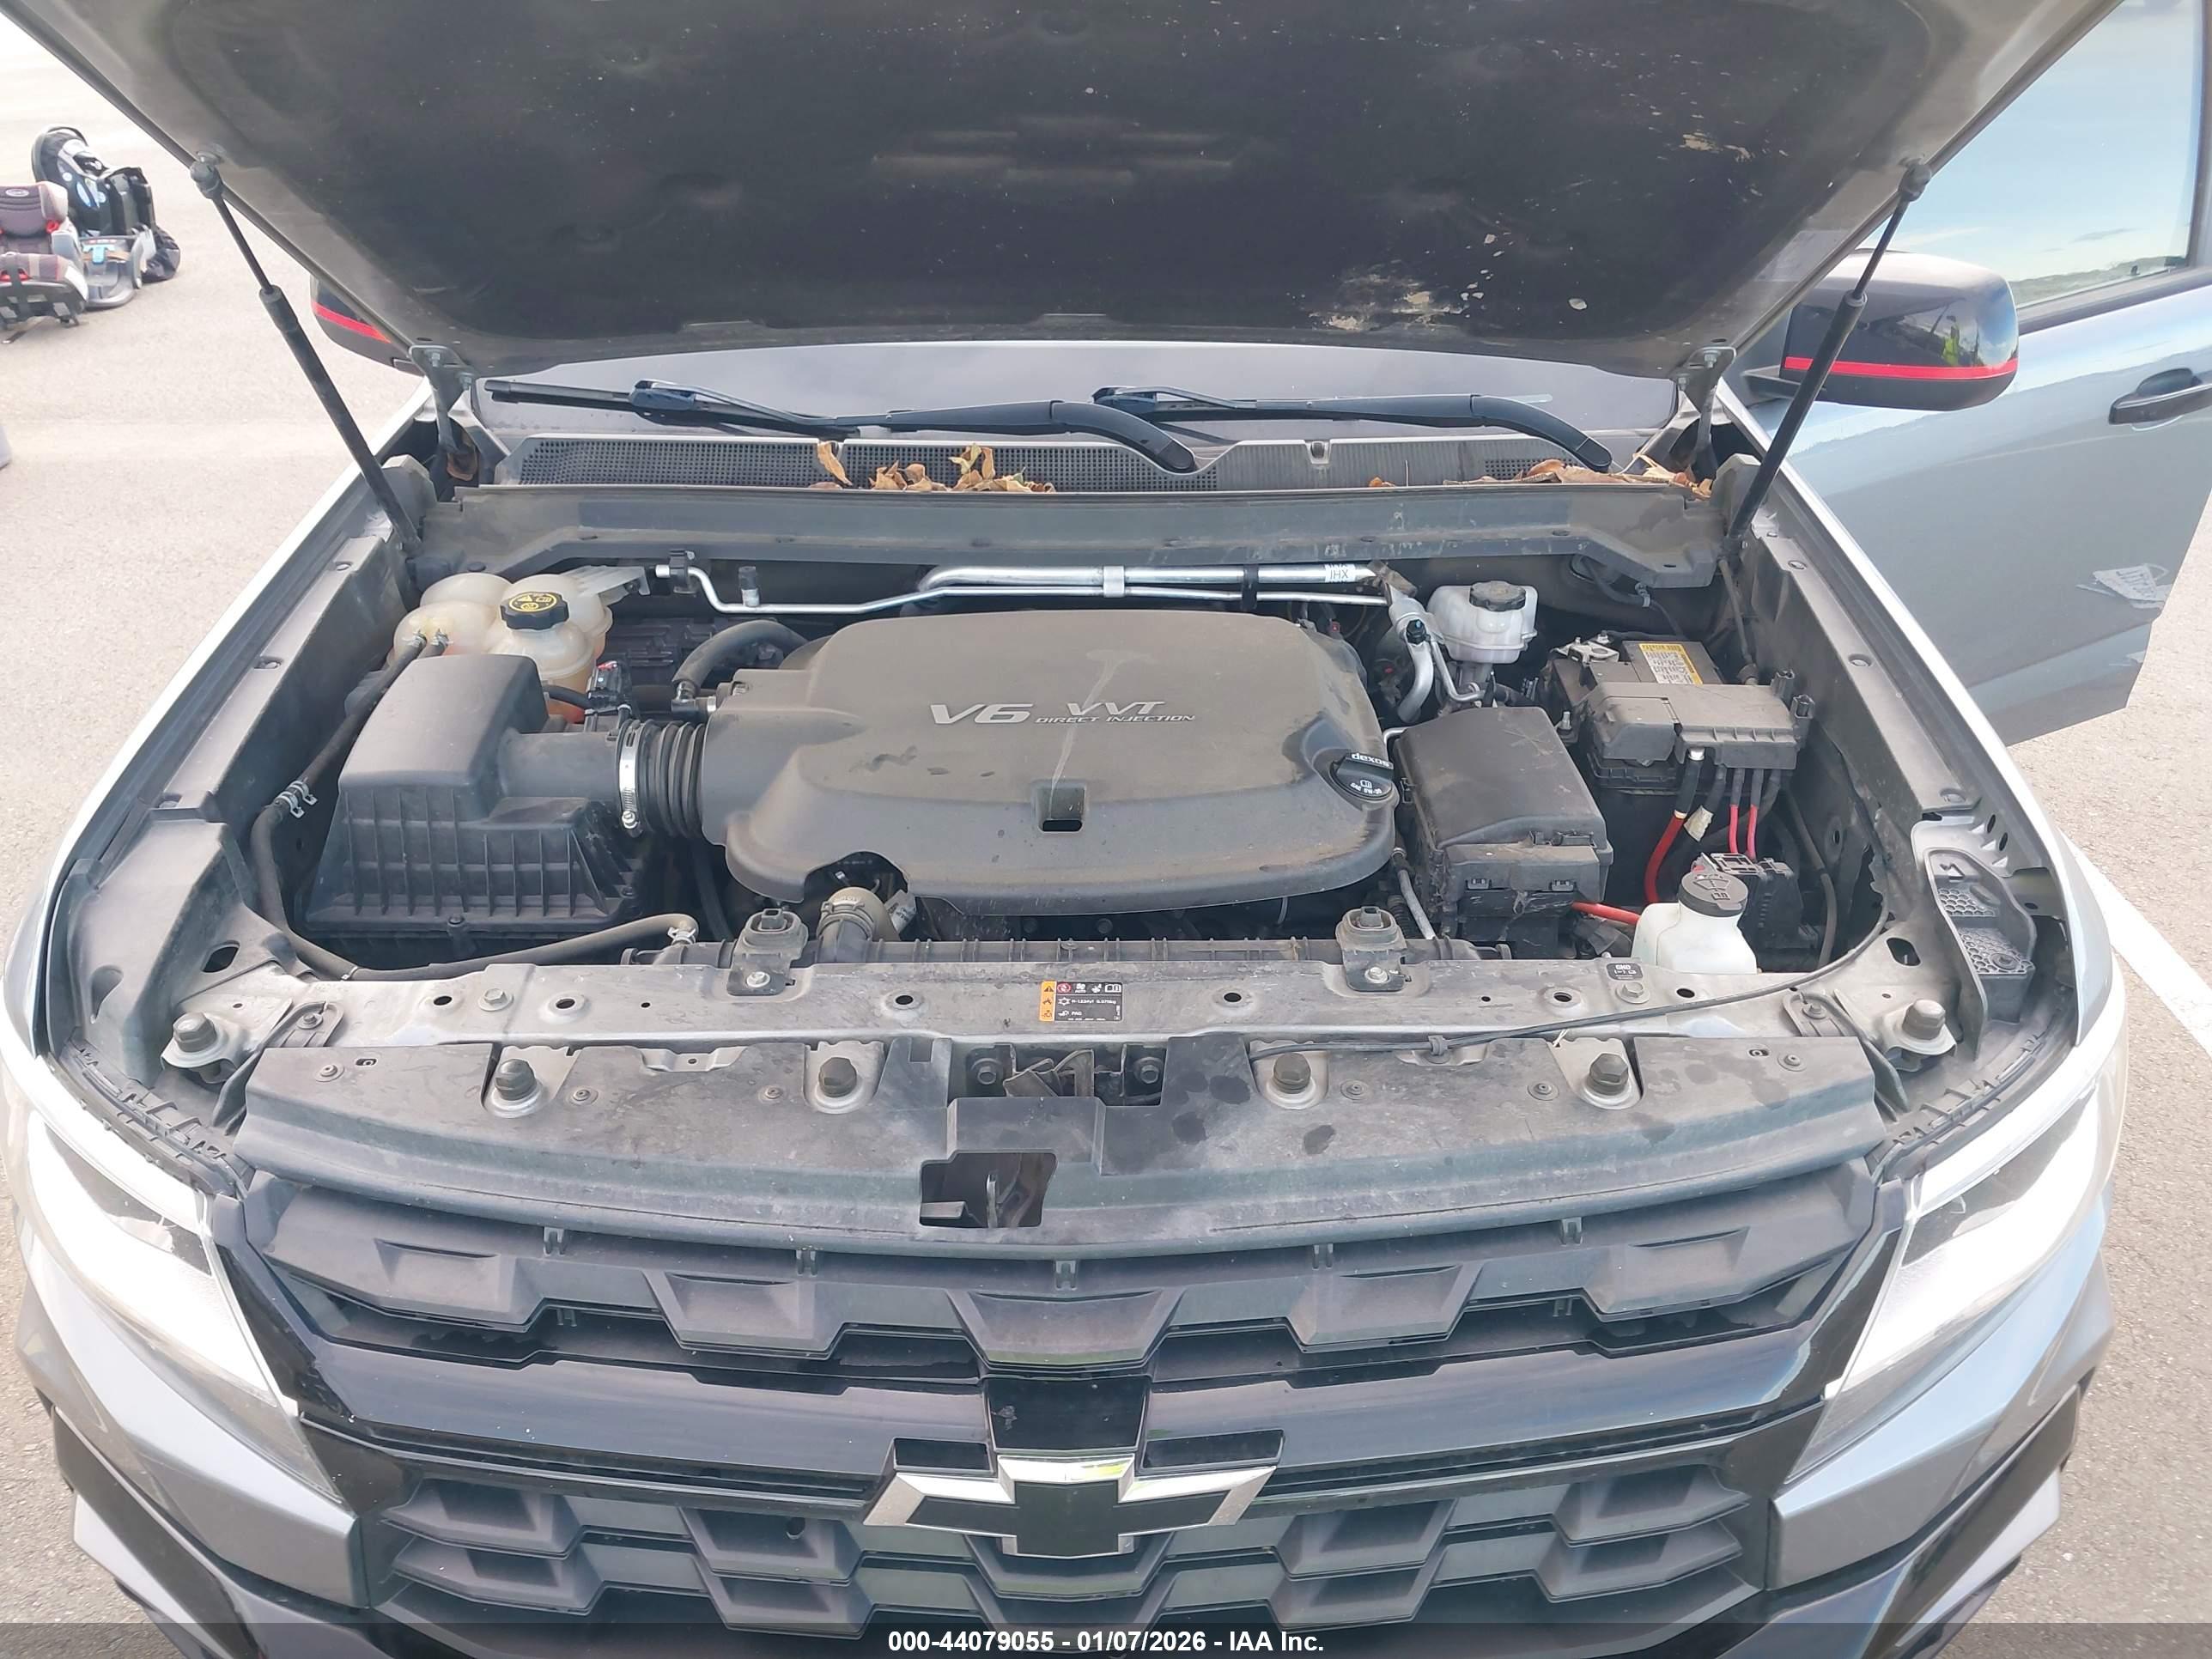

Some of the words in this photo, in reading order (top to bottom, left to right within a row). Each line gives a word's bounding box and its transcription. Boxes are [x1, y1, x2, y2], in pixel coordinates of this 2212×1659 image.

[1330, 569, 1349, 580] IHX
[930, 703, 1033, 724] V6
[1066, 701, 1164, 716] VVT
[1106, 714, 1195, 723] INJECTION
[1351, 752, 1390, 768] dexos
